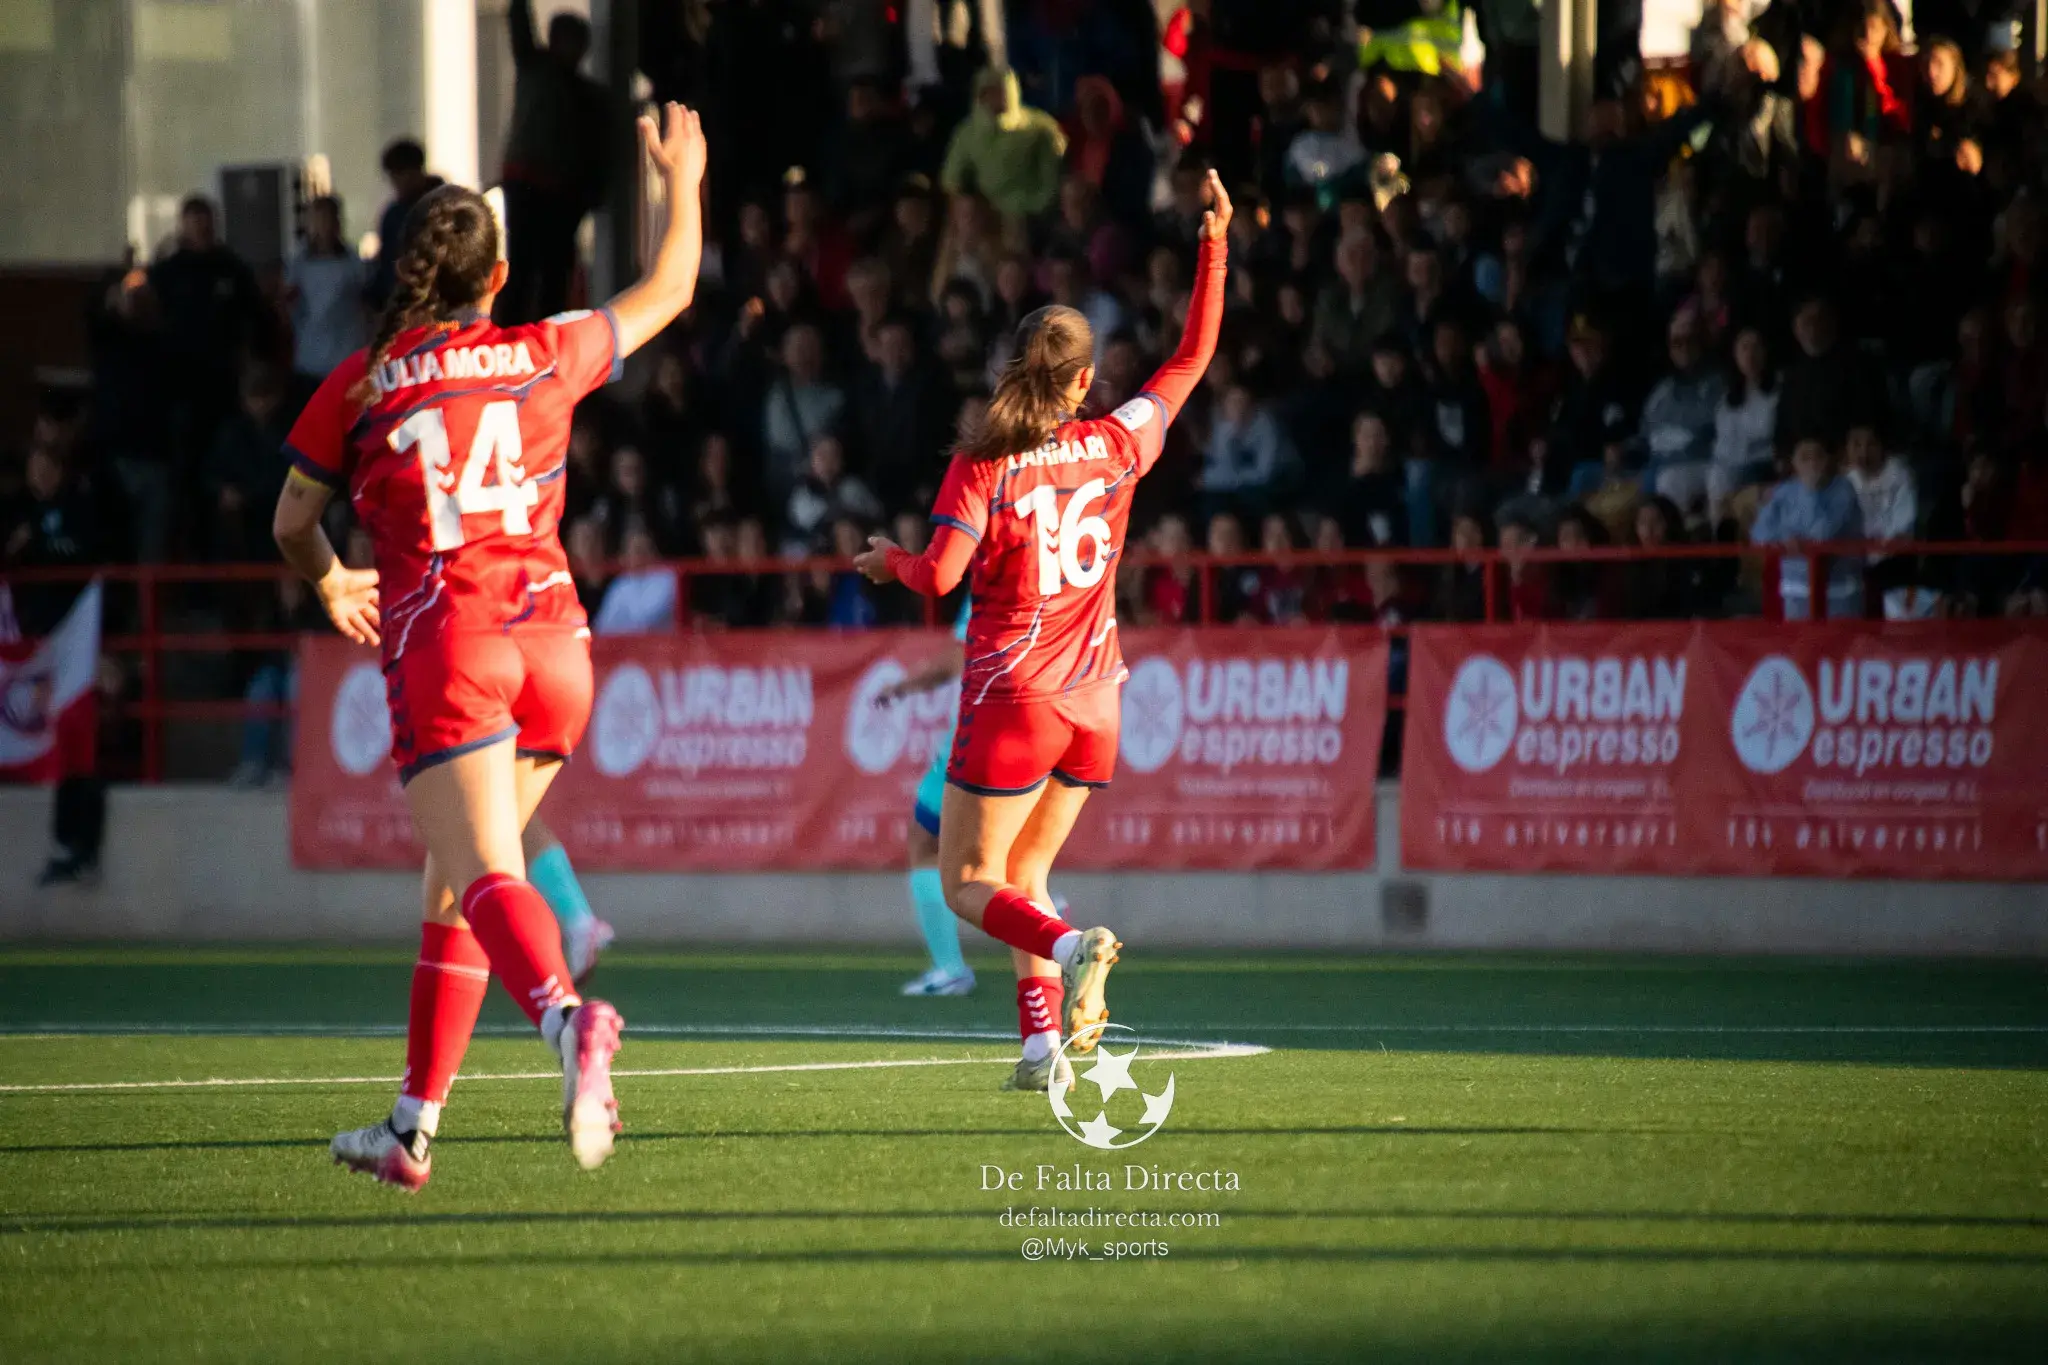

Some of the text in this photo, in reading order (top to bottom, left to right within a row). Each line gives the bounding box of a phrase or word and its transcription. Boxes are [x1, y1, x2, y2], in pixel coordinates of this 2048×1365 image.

[443, 342, 536, 380] MORA
[386, 399, 538, 552] 14
[1014, 477, 1112, 596] 16
[659, 666, 813, 728] URBAN
[1185, 659, 1349, 724] URBAN
[1521, 657, 1687, 722] URBAN
[1818, 658, 1998, 724] URBAN
[1181, 726, 1342, 775] espresso
[1516, 726, 1680, 777] espresso
[1813, 726, 1993, 777] espresso
